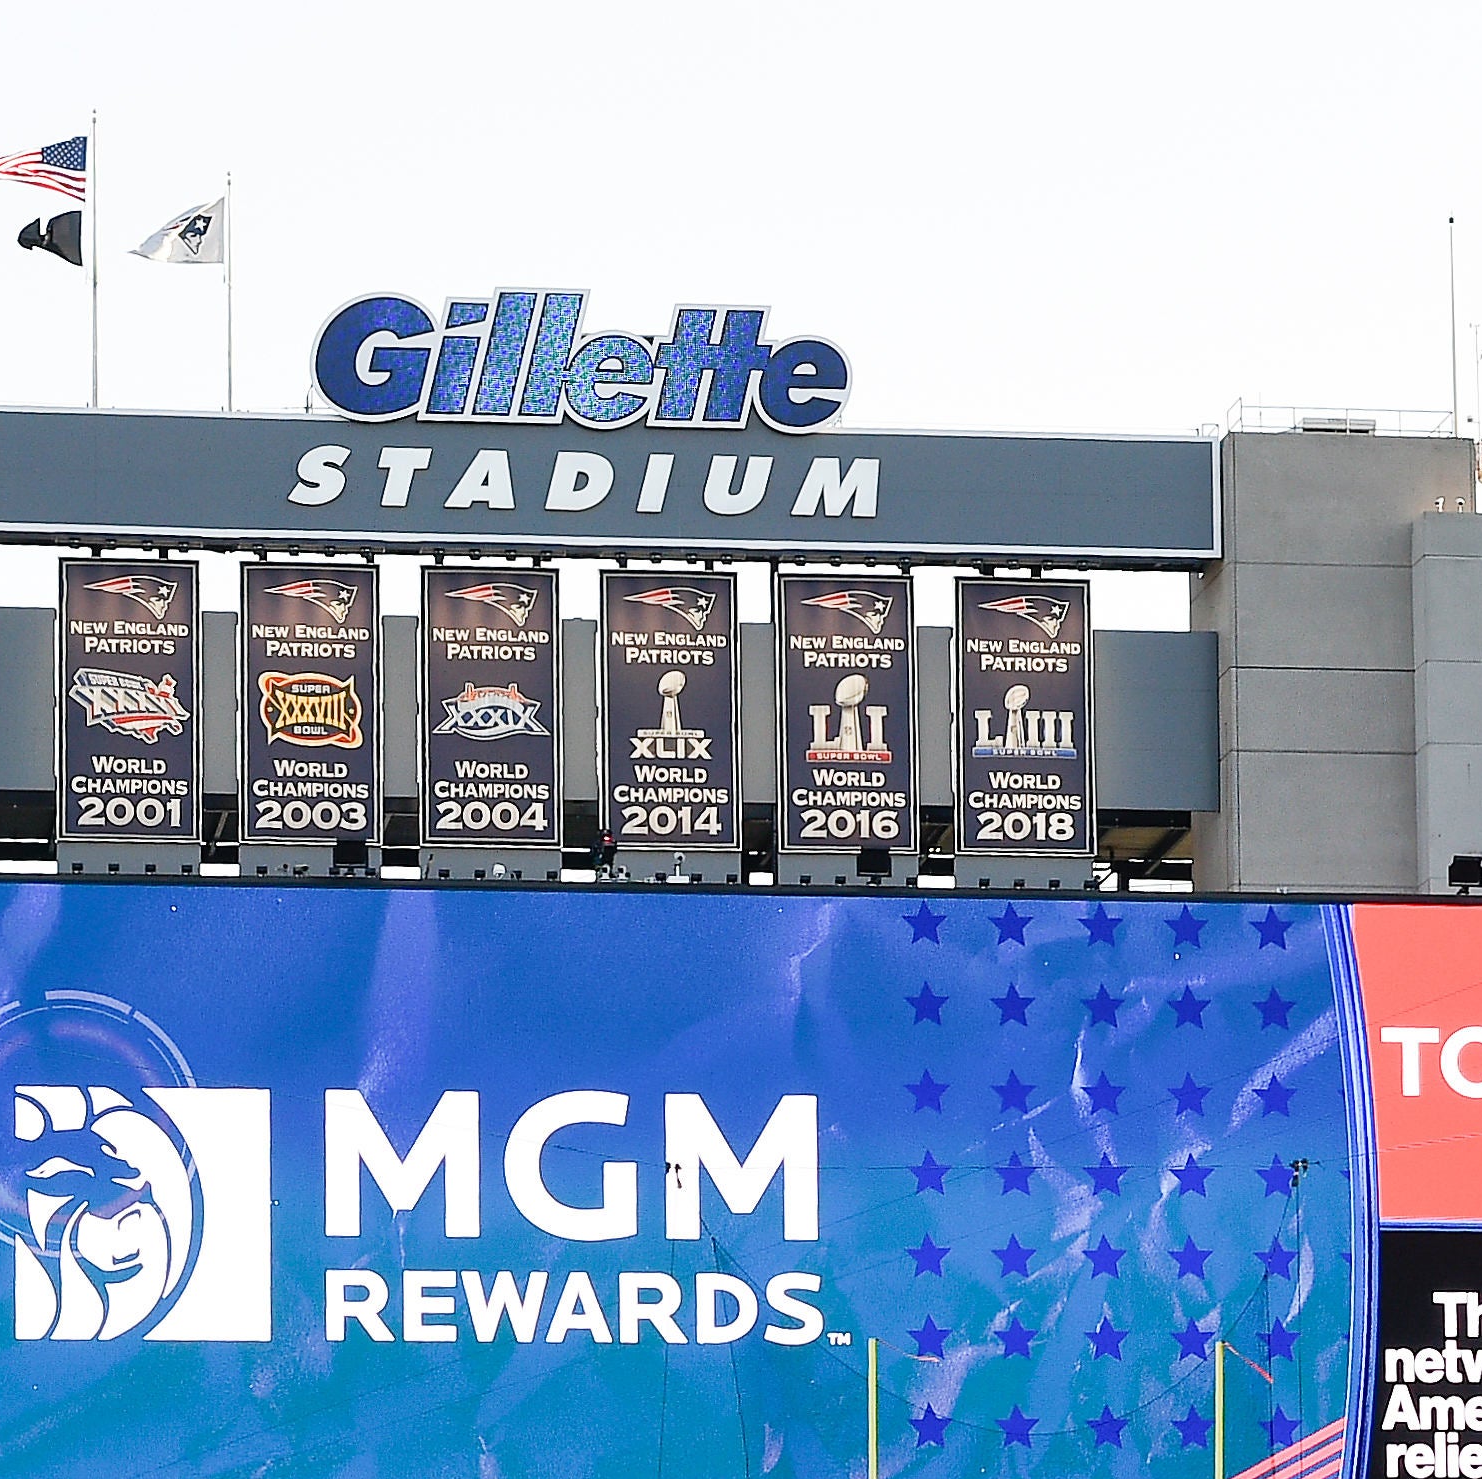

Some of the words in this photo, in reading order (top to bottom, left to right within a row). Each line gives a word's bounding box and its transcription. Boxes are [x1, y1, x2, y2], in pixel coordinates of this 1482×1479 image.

[314, 290, 850, 428] Gillette
[288, 444, 880, 520] STADIUM
[71, 620, 107, 635] NEW
[114, 621, 189, 637] ENGLAND
[252, 625, 289, 639] NEW
[295, 625, 370, 641] ENGLAND
[433, 627, 469, 642] NEW
[476, 627, 549, 643] ENGLAND
[85, 637, 175, 655] PATRIOTS
[611, 632, 648, 646] NEW
[654, 632, 727, 648] ENGLAND
[789, 635, 826, 649] NEW
[832, 635, 905, 651] ENGLAND
[966, 639, 1003, 653] NEW
[1008, 640, 1081, 656] ENGLAND
[266, 641, 355, 659] PATRIOTS
[447, 644, 536, 661] PATRIOTS
[625, 648, 714, 665] PATRIOTS
[804, 651, 892, 669] PATRIOTS
[980, 655, 1068, 673] PATRIOTS
[291, 684, 330, 694] SUPER
[293, 725, 328, 736] BOWL
[629, 738, 713, 760] XLIX
[816, 752, 850, 761] SUPER
[853, 752, 882, 761] BOWL
[92, 756, 167, 774] WORLD
[273, 759, 348, 778] WORLD
[455, 761, 528, 779] WORLD
[633, 765, 707, 783] WORLD
[71, 776, 188, 796] CHAMPIONS
[812, 769, 886, 787] WORLD
[989, 771, 1061, 790] WORLD
[253, 779, 369, 799] CHAMPIONS
[434, 781, 550, 800] CHAMPIONS
[613, 786, 729, 804] CHAMPIONS
[792, 789, 906, 808] CHAMPIONS
[969, 791, 1082, 811] CHAMPIONS
[77, 797, 182, 828] 2001
[255, 800, 368, 831] 2003
[435, 801, 548, 831] 2004
[621, 806, 723, 836] 2014
[800, 809, 900, 840] 2016
[976, 811, 1075, 842] 2018
[324, 1088, 821, 1241] MGM
[324, 1269, 825, 1346] REWARDS
